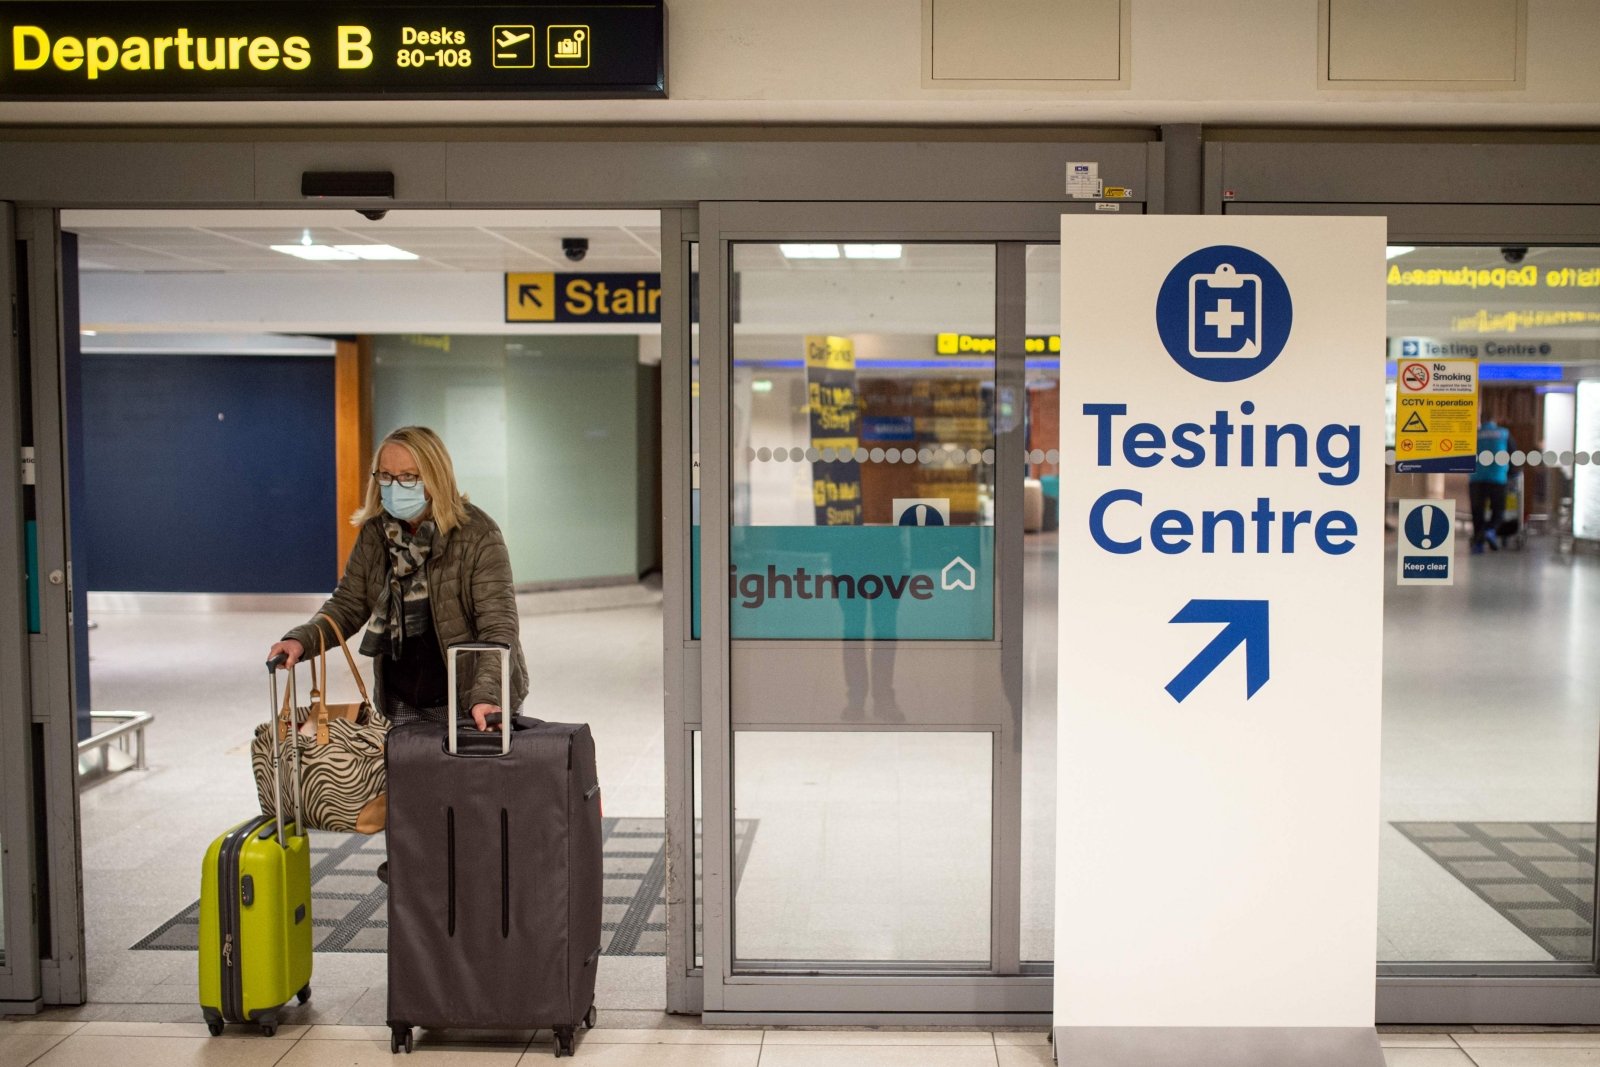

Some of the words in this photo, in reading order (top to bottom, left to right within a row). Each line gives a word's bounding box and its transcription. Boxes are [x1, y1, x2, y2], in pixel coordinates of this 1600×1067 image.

[402, 27, 466, 45] Desks
[13, 26, 311, 80] Departures
[338, 25, 374, 70] B
[396, 49, 472, 68] 80-108
[565, 279, 661, 316] Stair
[1424, 341, 1479, 357] Testing
[1485, 341, 1537, 357] Centre
[1433, 363, 1446, 371] No
[1433, 373, 1471, 382] Smoking
[1401, 398, 1425, 406] CCTV
[1436, 399, 1474, 407] operation
[1083, 400, 1361, 486] Testing
[1089, 489, 1358, 555] Centre
[1404, 563, 1425, 572] Keep
[1427, 563, 1447, 571] clear
[731, 565, 934, 608] ightmove
